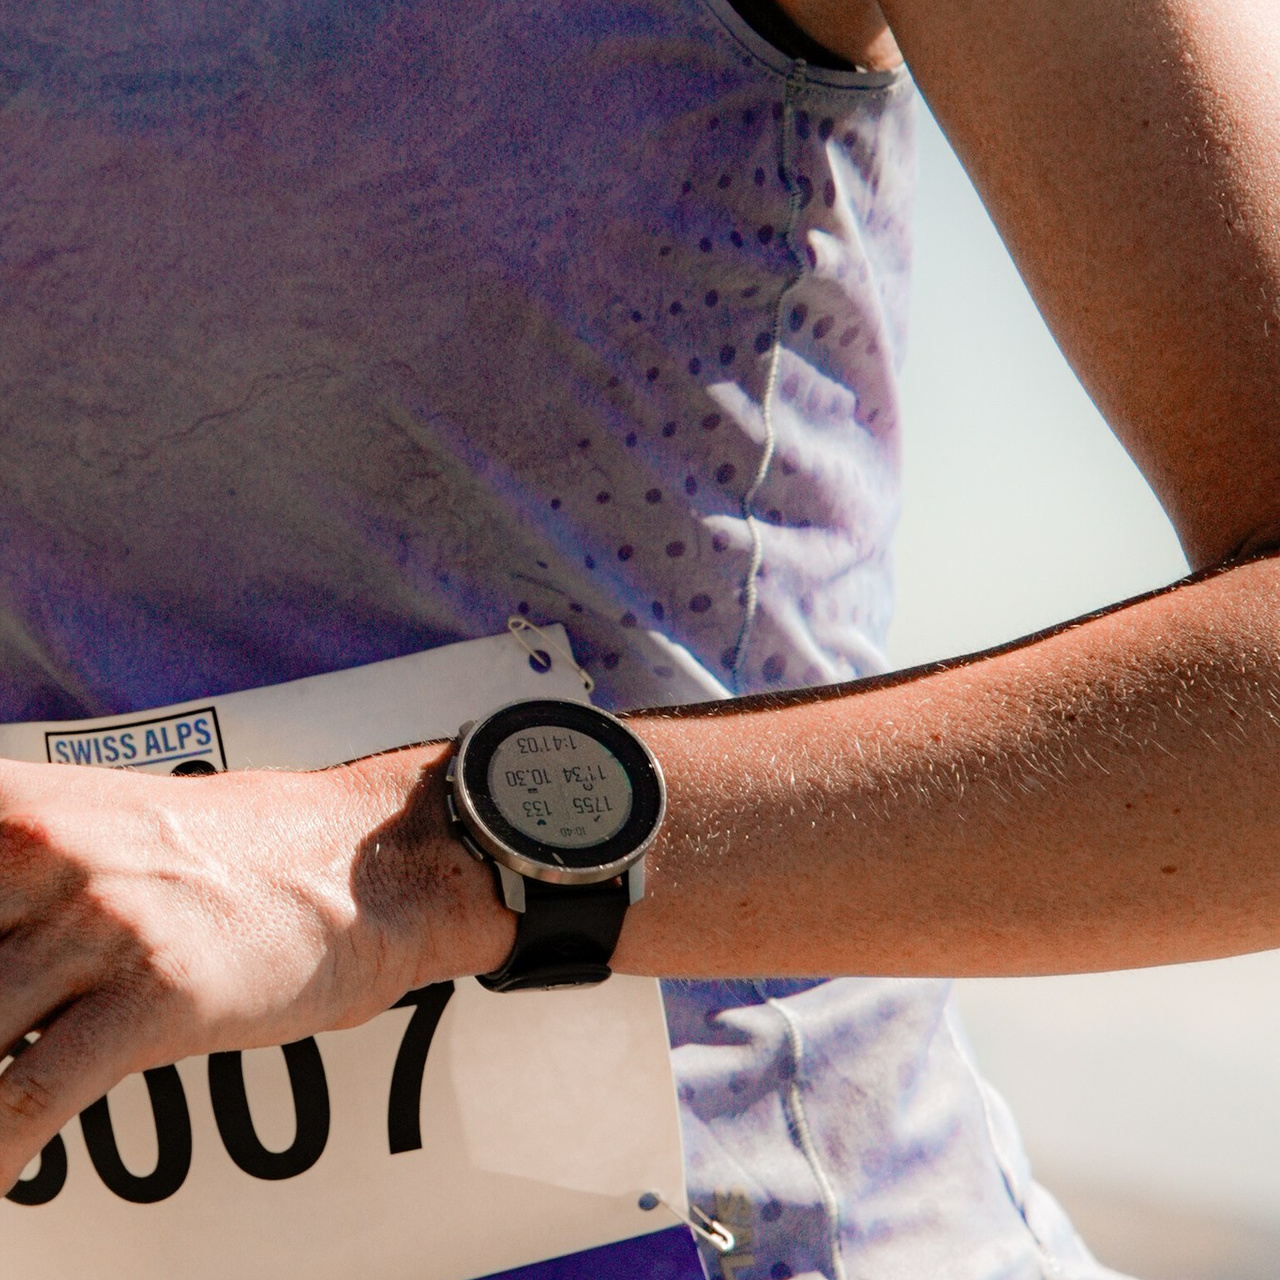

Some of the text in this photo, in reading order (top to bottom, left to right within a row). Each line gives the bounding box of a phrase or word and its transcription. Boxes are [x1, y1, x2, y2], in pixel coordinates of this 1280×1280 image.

[55, 719, 211, 765] SWISS ALPS
[506, 769, 552, 787] 10.30
[523, 800, 552, 818] 133
[573, 796, 613, 814] 1755
